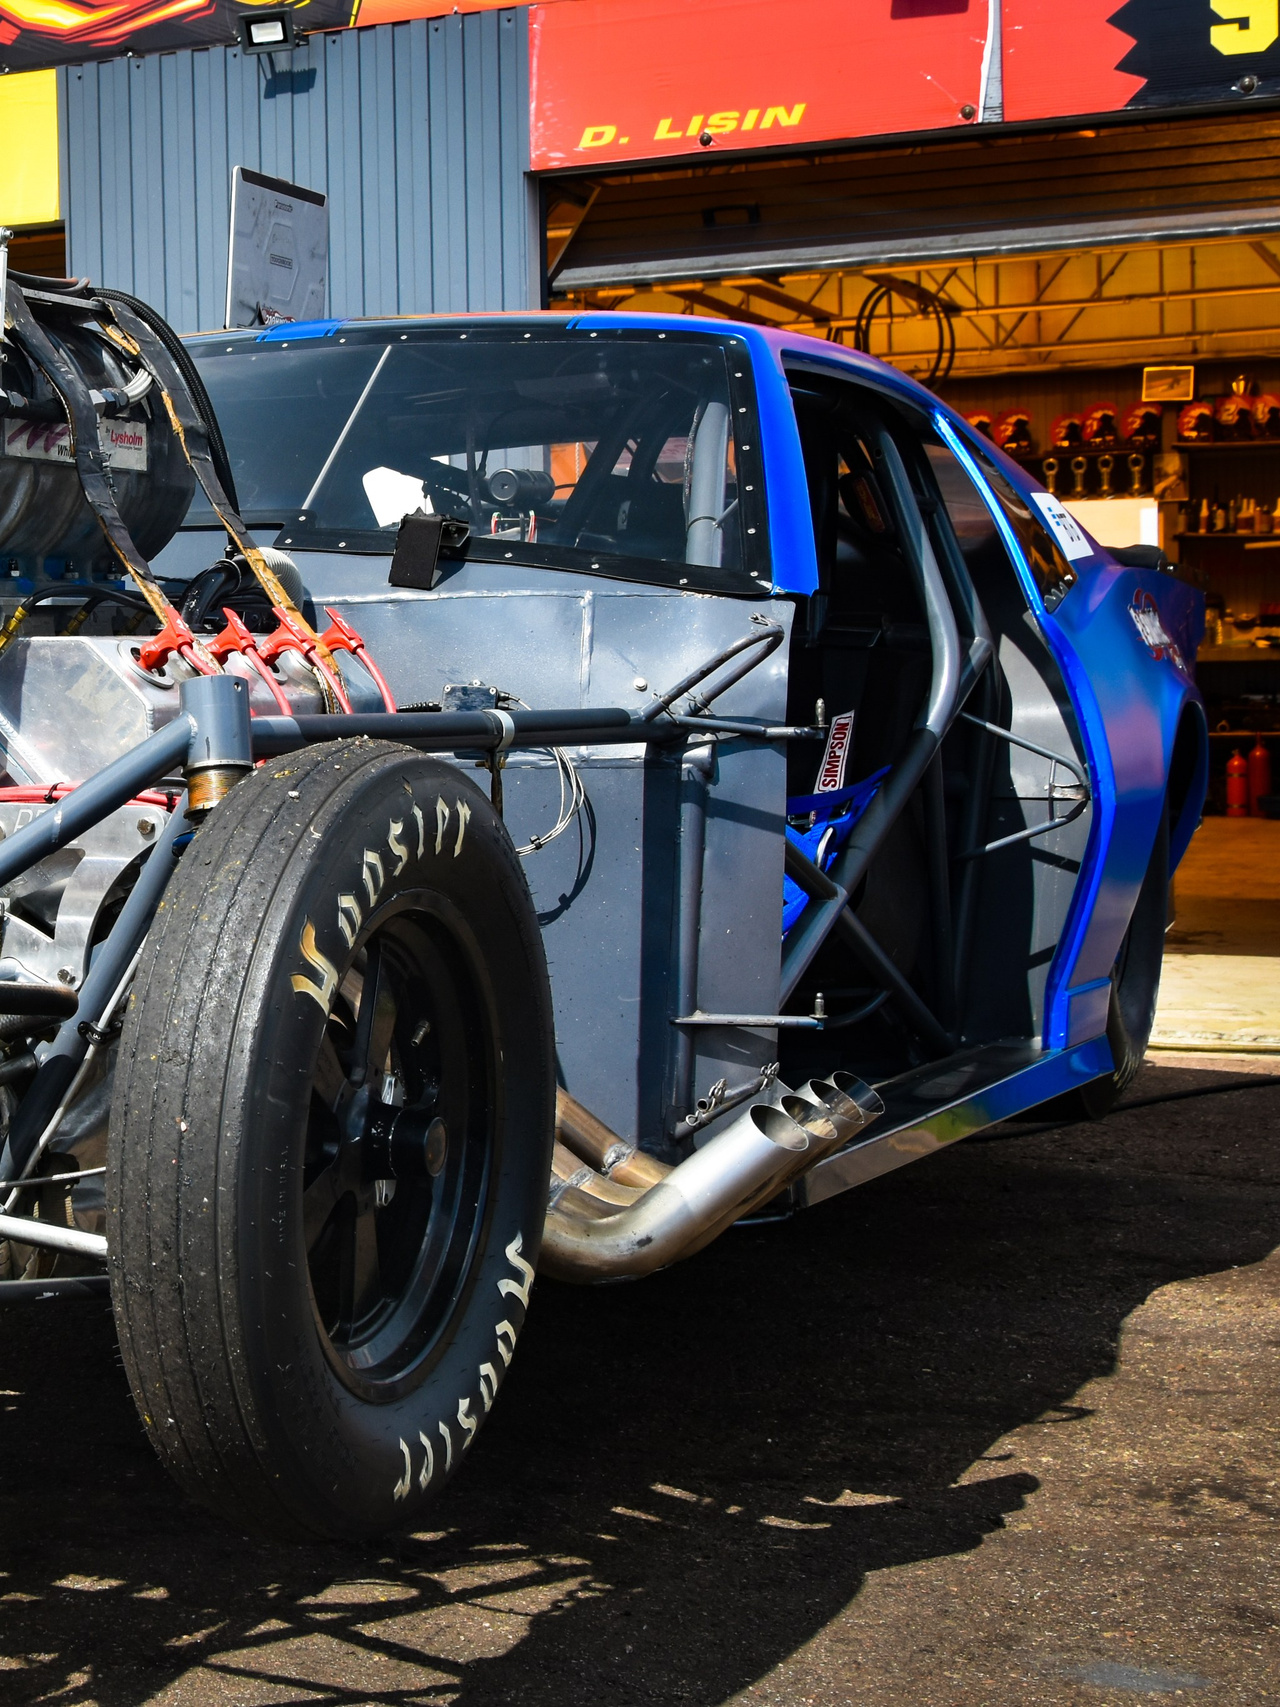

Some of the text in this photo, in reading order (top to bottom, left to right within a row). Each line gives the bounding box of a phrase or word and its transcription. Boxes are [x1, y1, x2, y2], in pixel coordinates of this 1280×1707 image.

[578, 103, 807, 148] D. LISIN
[110, 430, 143, 447] Lysholm
[822, 722, 850, 788] SIMPSON
